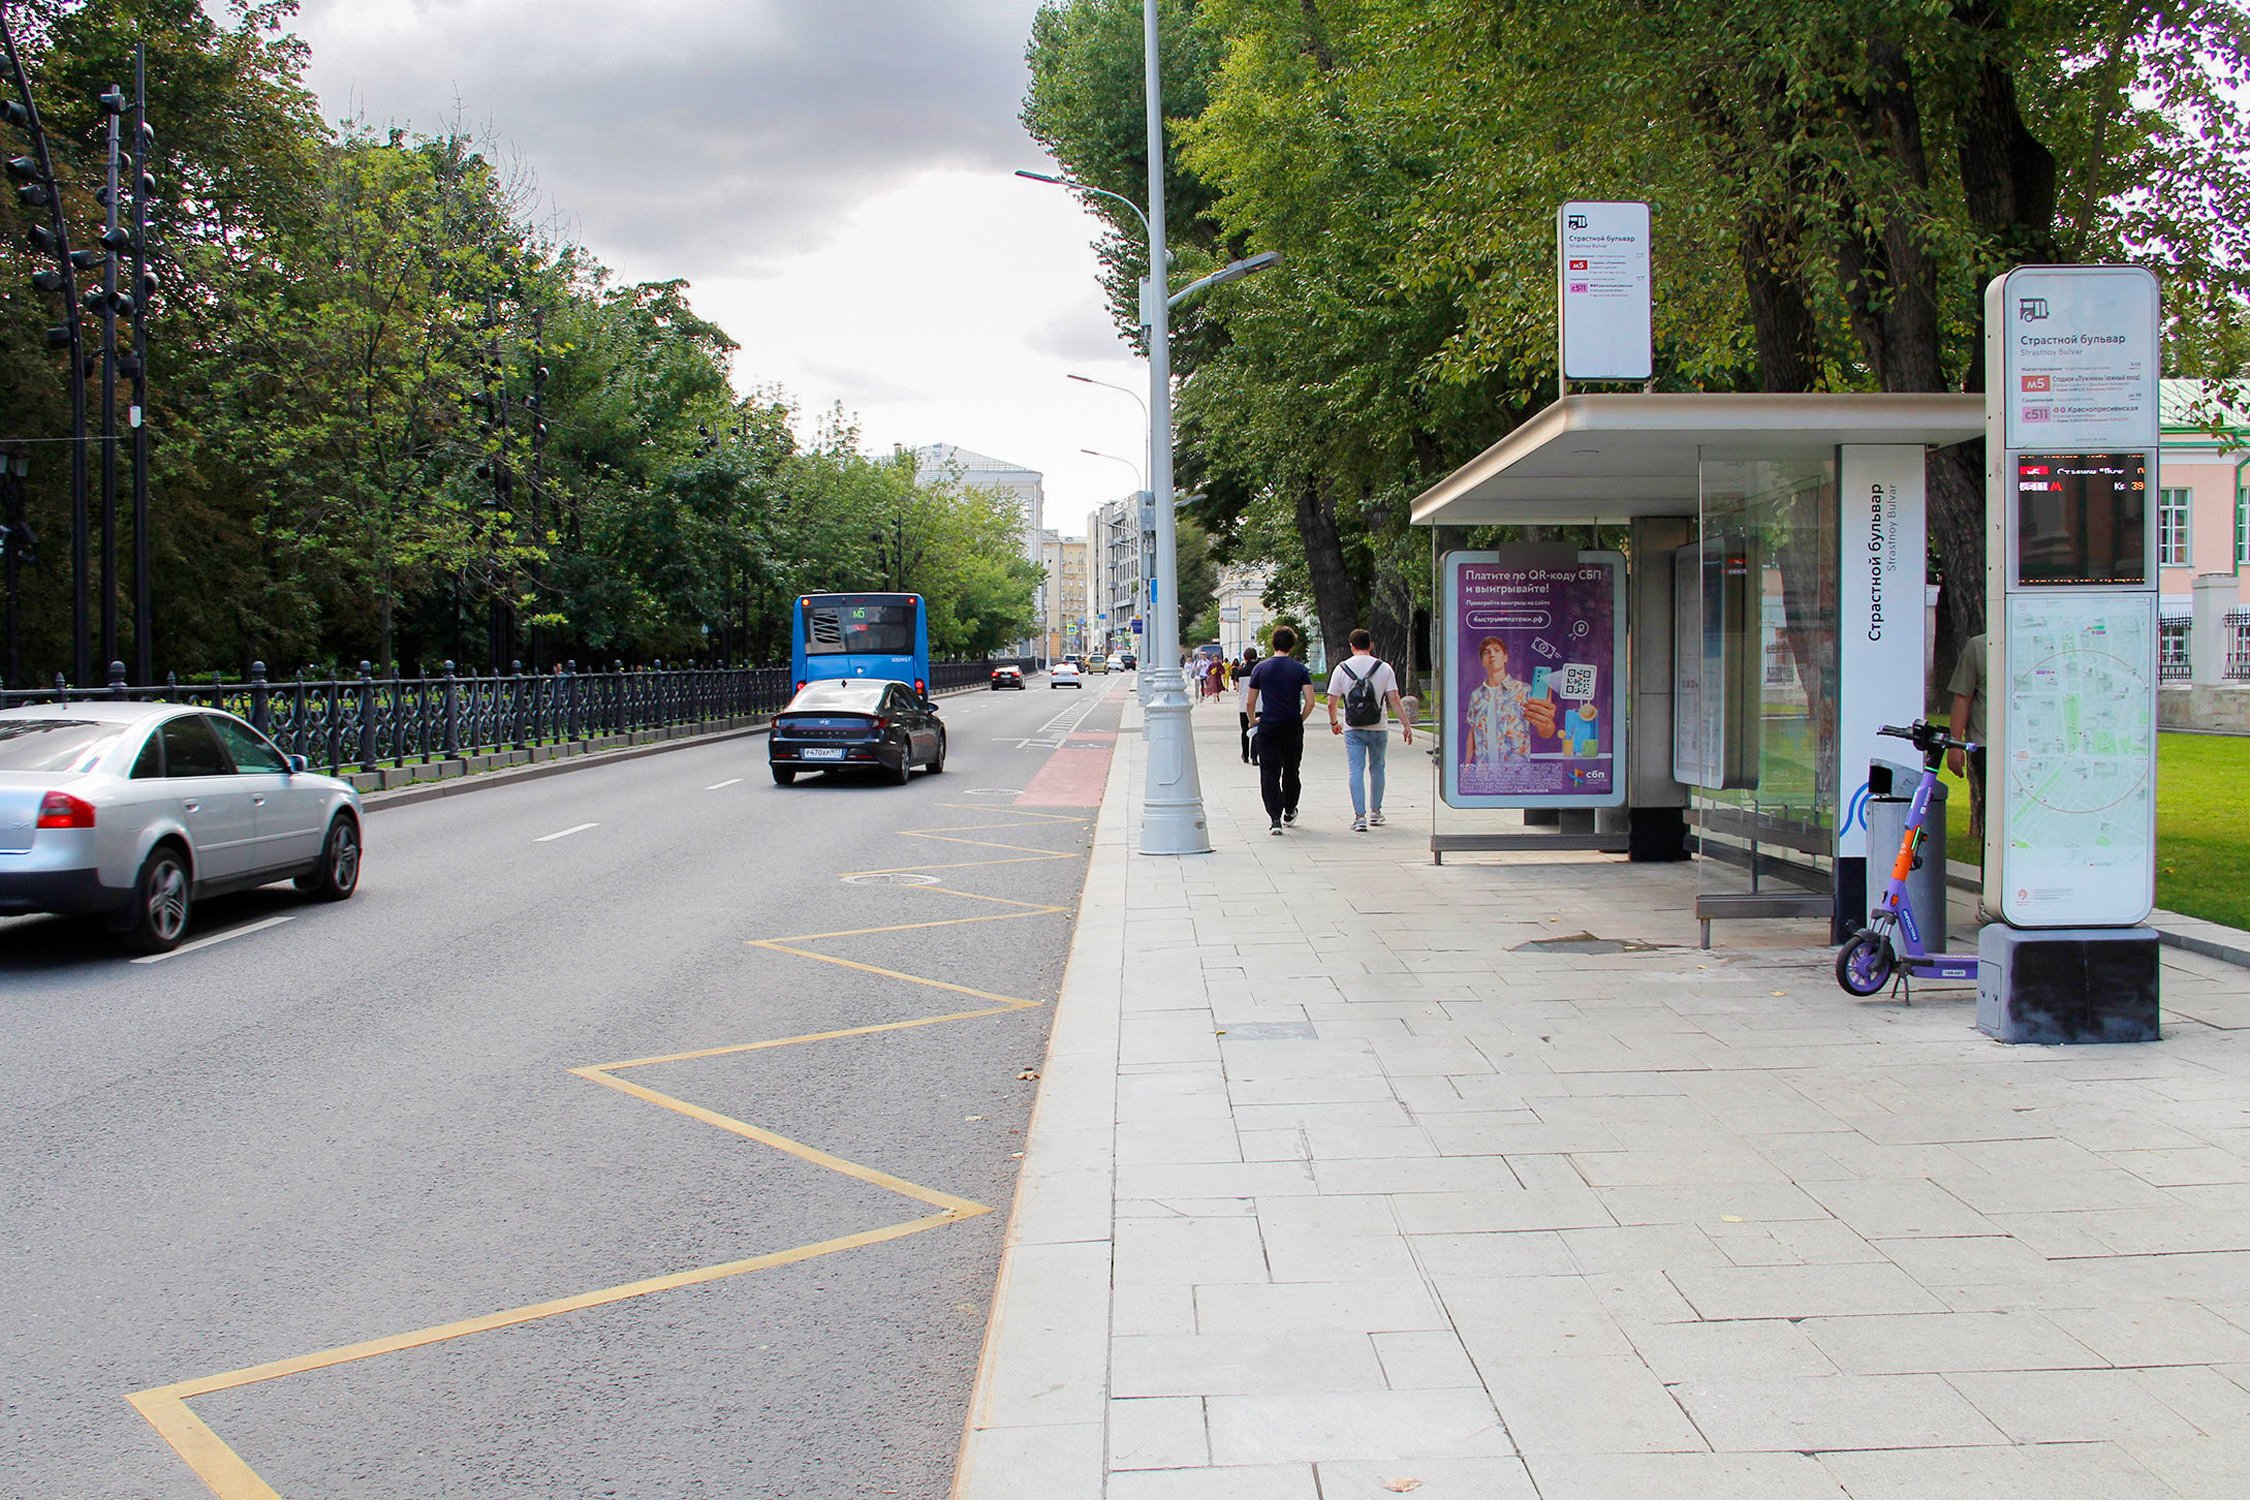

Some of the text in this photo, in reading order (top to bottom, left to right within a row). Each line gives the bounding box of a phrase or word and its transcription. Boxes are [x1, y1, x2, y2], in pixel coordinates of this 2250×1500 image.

[1568, 234, 1636, 243] Страстной бульвар
[2020, 333, 2126, 347] Страстной бульвар
[2020, 348, 2083, 357] Strastnoy Bulvar
[2026, 377, 2046, 389] м5
[2025, 409, 2048, 420] с511
[1886, 484, 1898, 572] Strastnoy Bulvar
[1867, 483, 1884, 642] Страстной бульвар
[1466, 570, 1602, 582] Платите по QR-коду СБП
[1475, 583, 1550, 596] выигрывайте!
[1585, 769, 1605, 779] сбп
